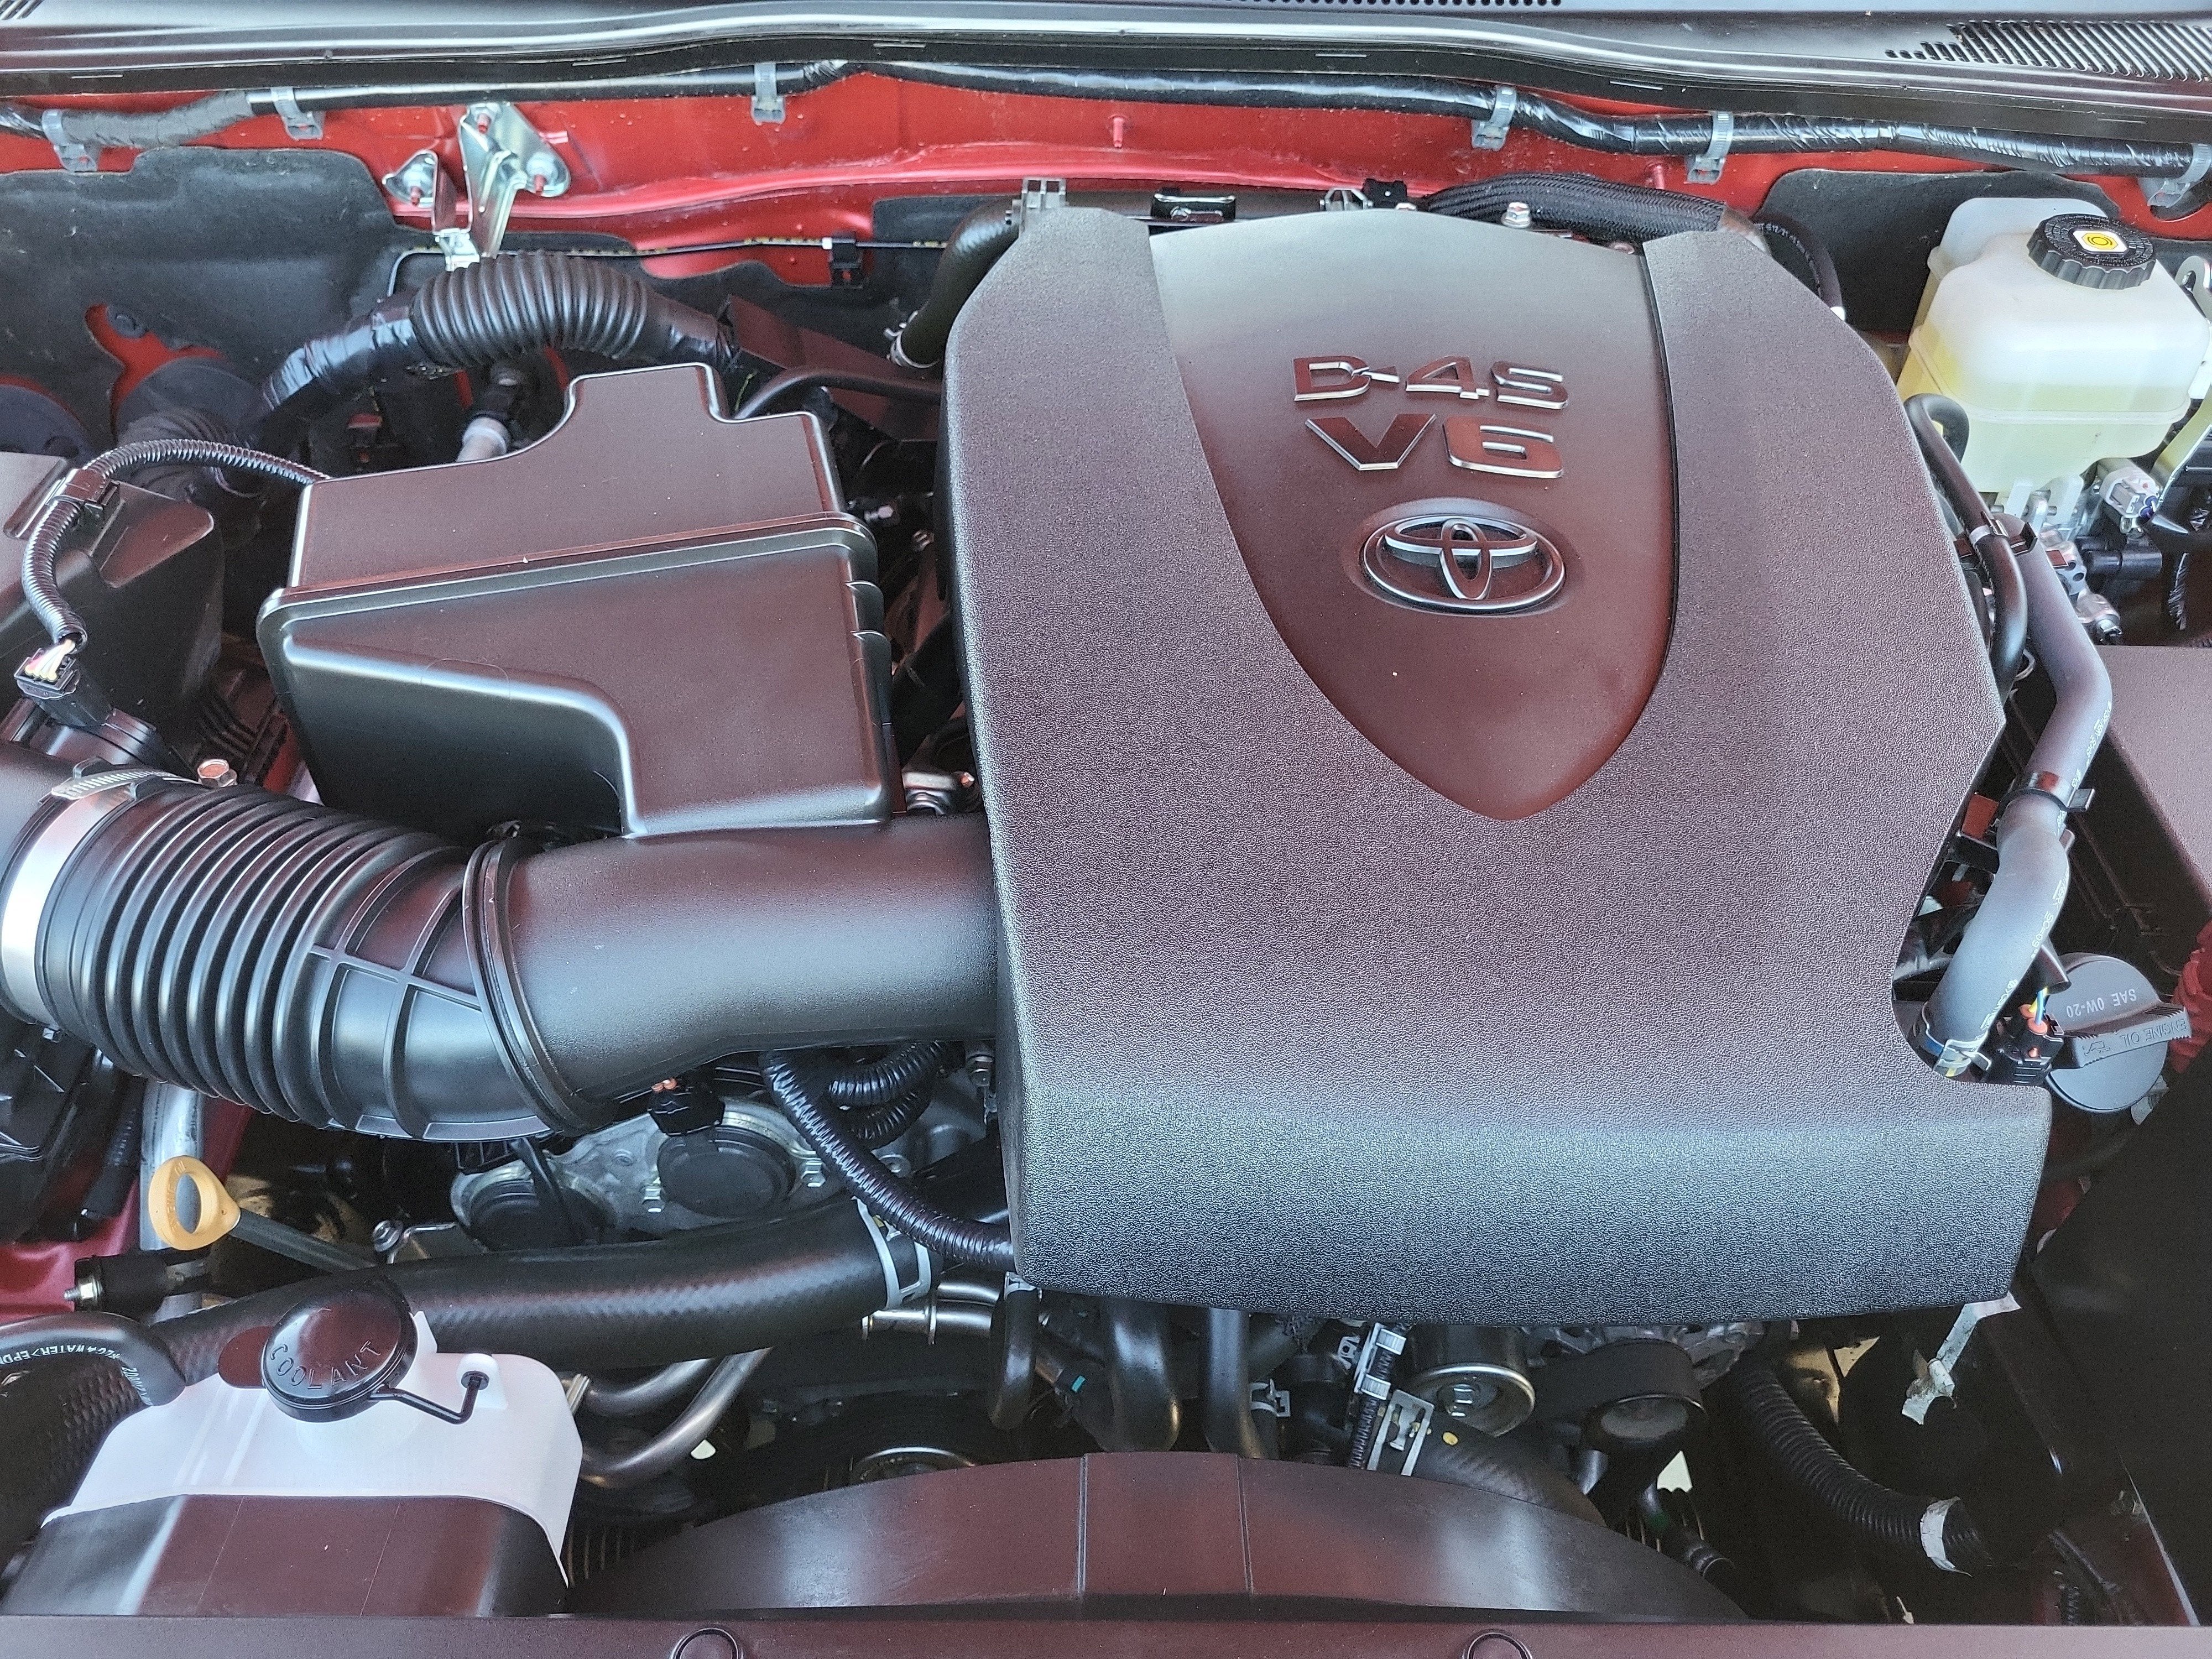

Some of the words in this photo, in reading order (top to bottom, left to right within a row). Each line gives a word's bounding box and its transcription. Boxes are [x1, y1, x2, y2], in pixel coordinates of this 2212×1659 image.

[1293, 356, 1568, 410] D-4S
[1305, 413, 1564, 479] V6
[2066, 997, 2105, 1019] 0W-20
[2111, 988, 2137, 1008] SAE
[2119, 1031, 2140, 1047] OIL
[2143, 1018, 2187, 1042] ENGINE
[270, 1340, 382, 1389] COOLANT
